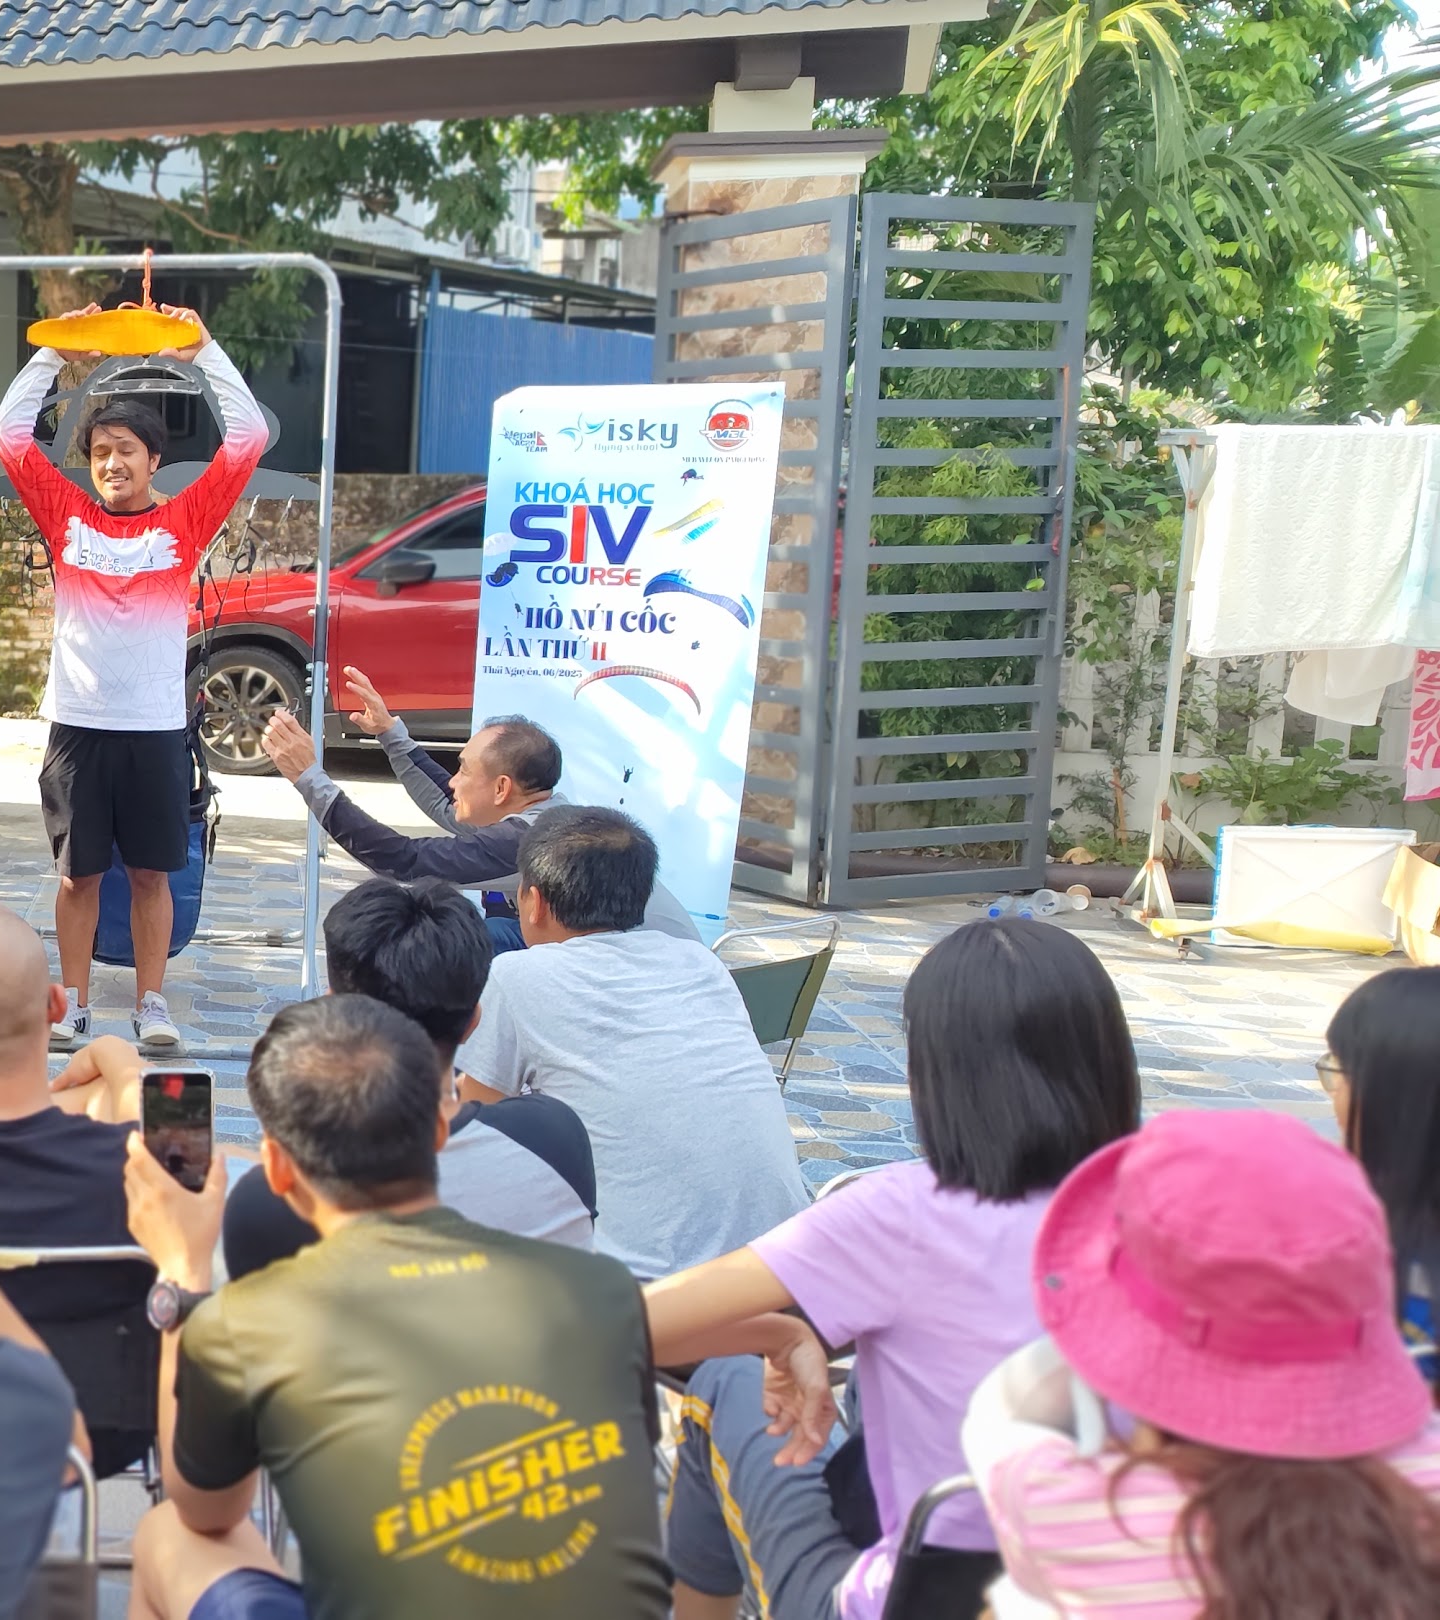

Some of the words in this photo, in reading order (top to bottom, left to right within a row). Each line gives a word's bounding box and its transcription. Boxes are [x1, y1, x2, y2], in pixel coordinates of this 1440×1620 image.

[607, 418, 679, 449] isky
[626, 443, 659, 451] school
[515, 477, 591, 503] KHOÁ
[598, 482, 655, 509] HỌC
[510, 504, 652, 565] SIV
[536, 566, 641, 586] COURSE
[569, 604, 614, 632] NÚI
[620, 598, 676, 634] CỐC
[484, 626, 533, 657] LẦN
